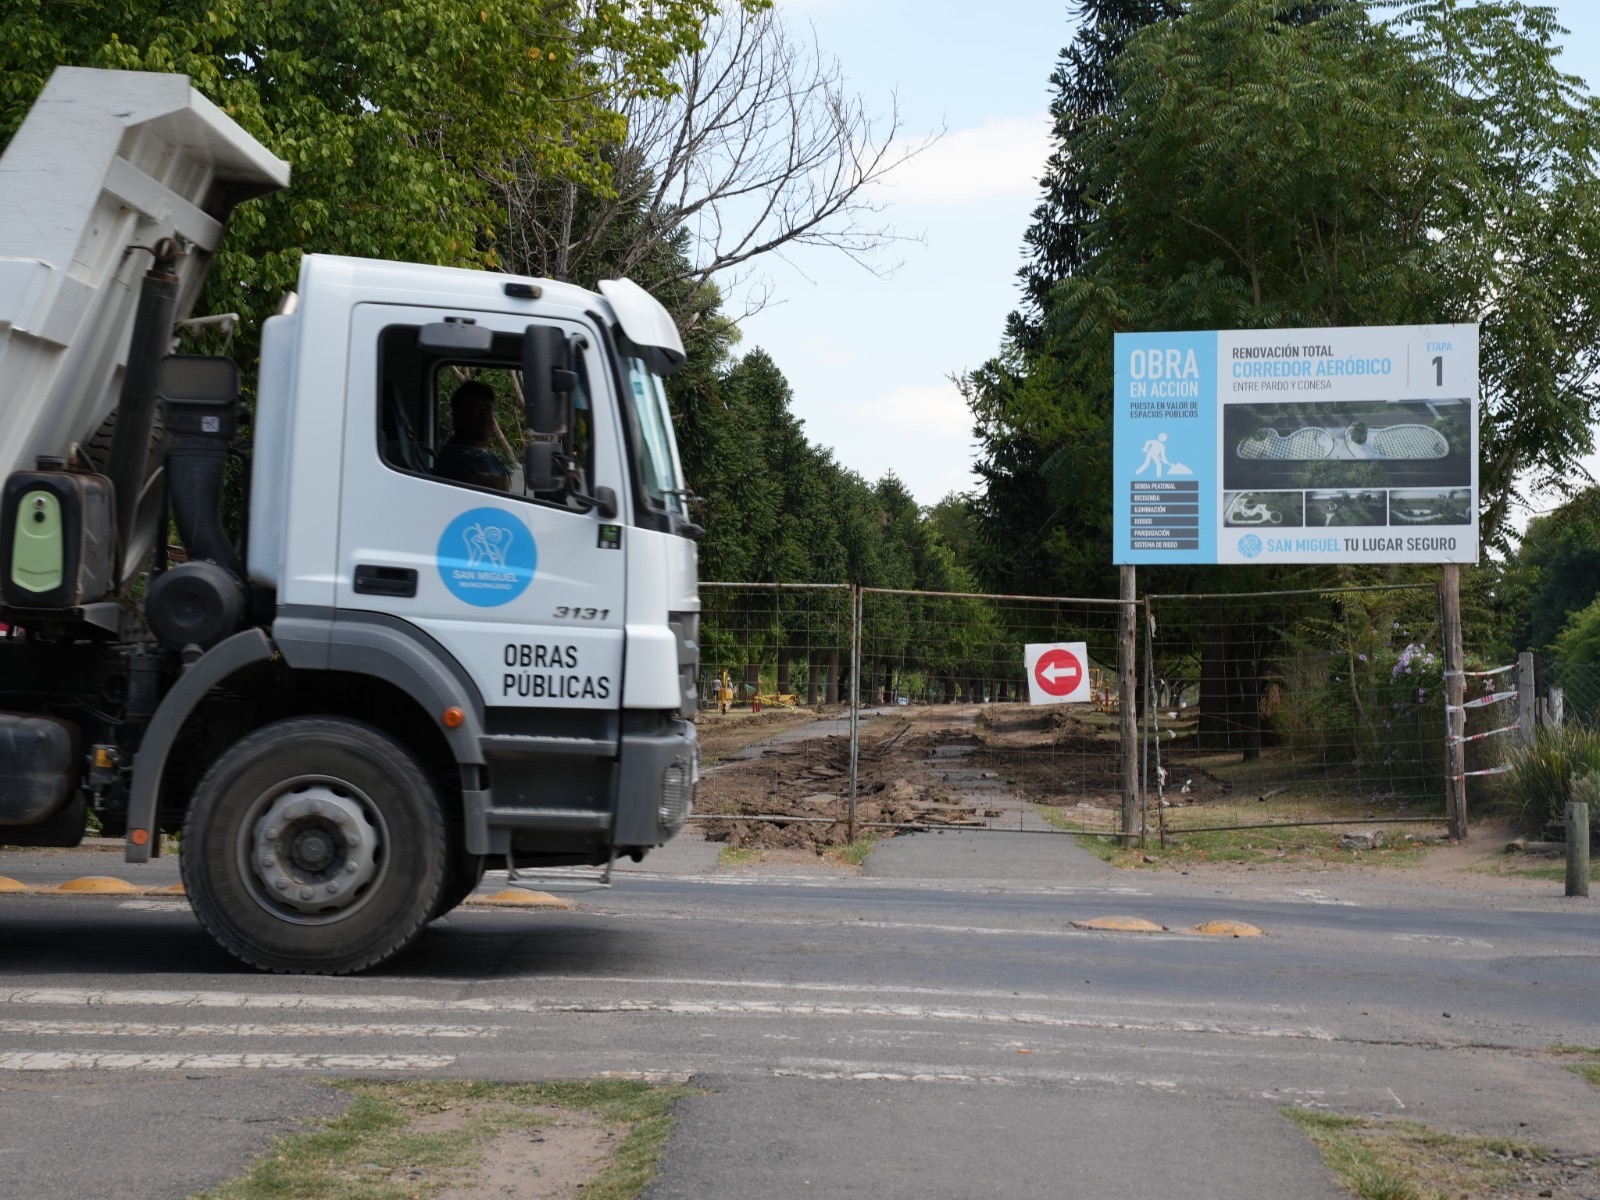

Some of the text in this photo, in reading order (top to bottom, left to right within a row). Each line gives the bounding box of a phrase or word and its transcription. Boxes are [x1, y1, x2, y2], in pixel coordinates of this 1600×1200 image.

[1232, 344, 1334, 359] RENOVACIÓN TOTAL
[1426, 342, 1453, 352] ETAPA
[1130, 348, 1199, 380] OBRA
[1232, 355, 1391, 378] CORREDOR AERÓBICO
[1431, 356, 1443, 387] 1
[1130, 379, 1199, 398] EN ACCIÓN
[1233, 379, 1332, 392] ENTRE PARDO Y CONESA
[1130, 402, 1155, 410] PUESTA
[1156, 402, 1165, 410] EN
[1189, 401, 1198, 409] DE
[1130, 411, 1163, 419] ESPACIOS
[1267, 537, 1456, 552] SAN MIGUEL TU LUGAR SEGURO
[452, 569, 518, 582] SAN MIGUEL
[552, 606, 611, 621] 3131
[504, 643, 578, 669] OBRAS
[503, 669, 610, 699] PÚBLICAS
